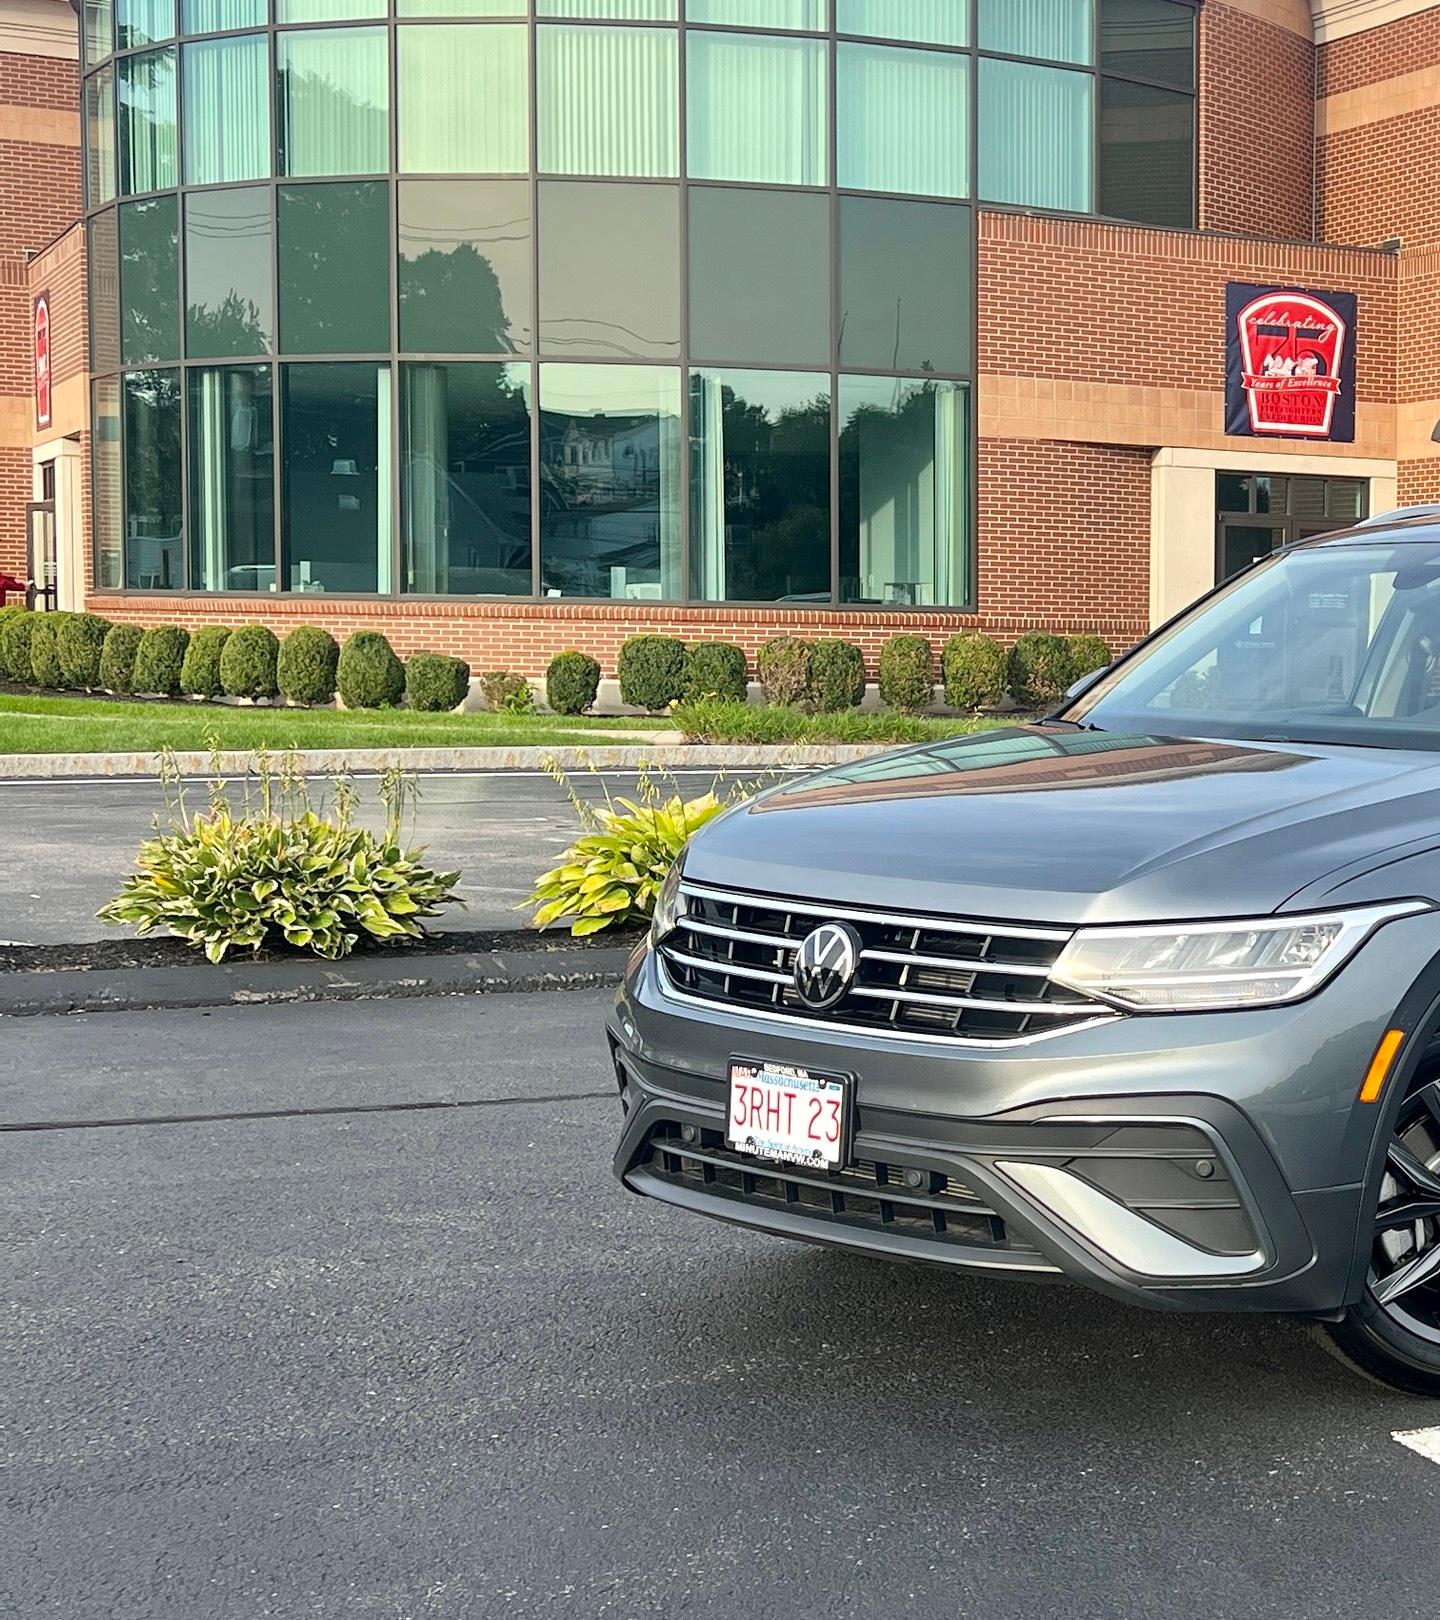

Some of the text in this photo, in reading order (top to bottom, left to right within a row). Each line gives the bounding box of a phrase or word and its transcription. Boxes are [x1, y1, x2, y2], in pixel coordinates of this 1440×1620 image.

[1248, 311, 1335, 343] celebrating
[1250, 376, 1333, 391] Years of Excellence
[1261, 391, 1321, 408] BOSTON
[757, 1070, 821, 1093] Massachusetts
[734, 1084, 841, 1143] 3RHT 23
[734, 1142, 829, 1169] MINUTEMANVW.COM
